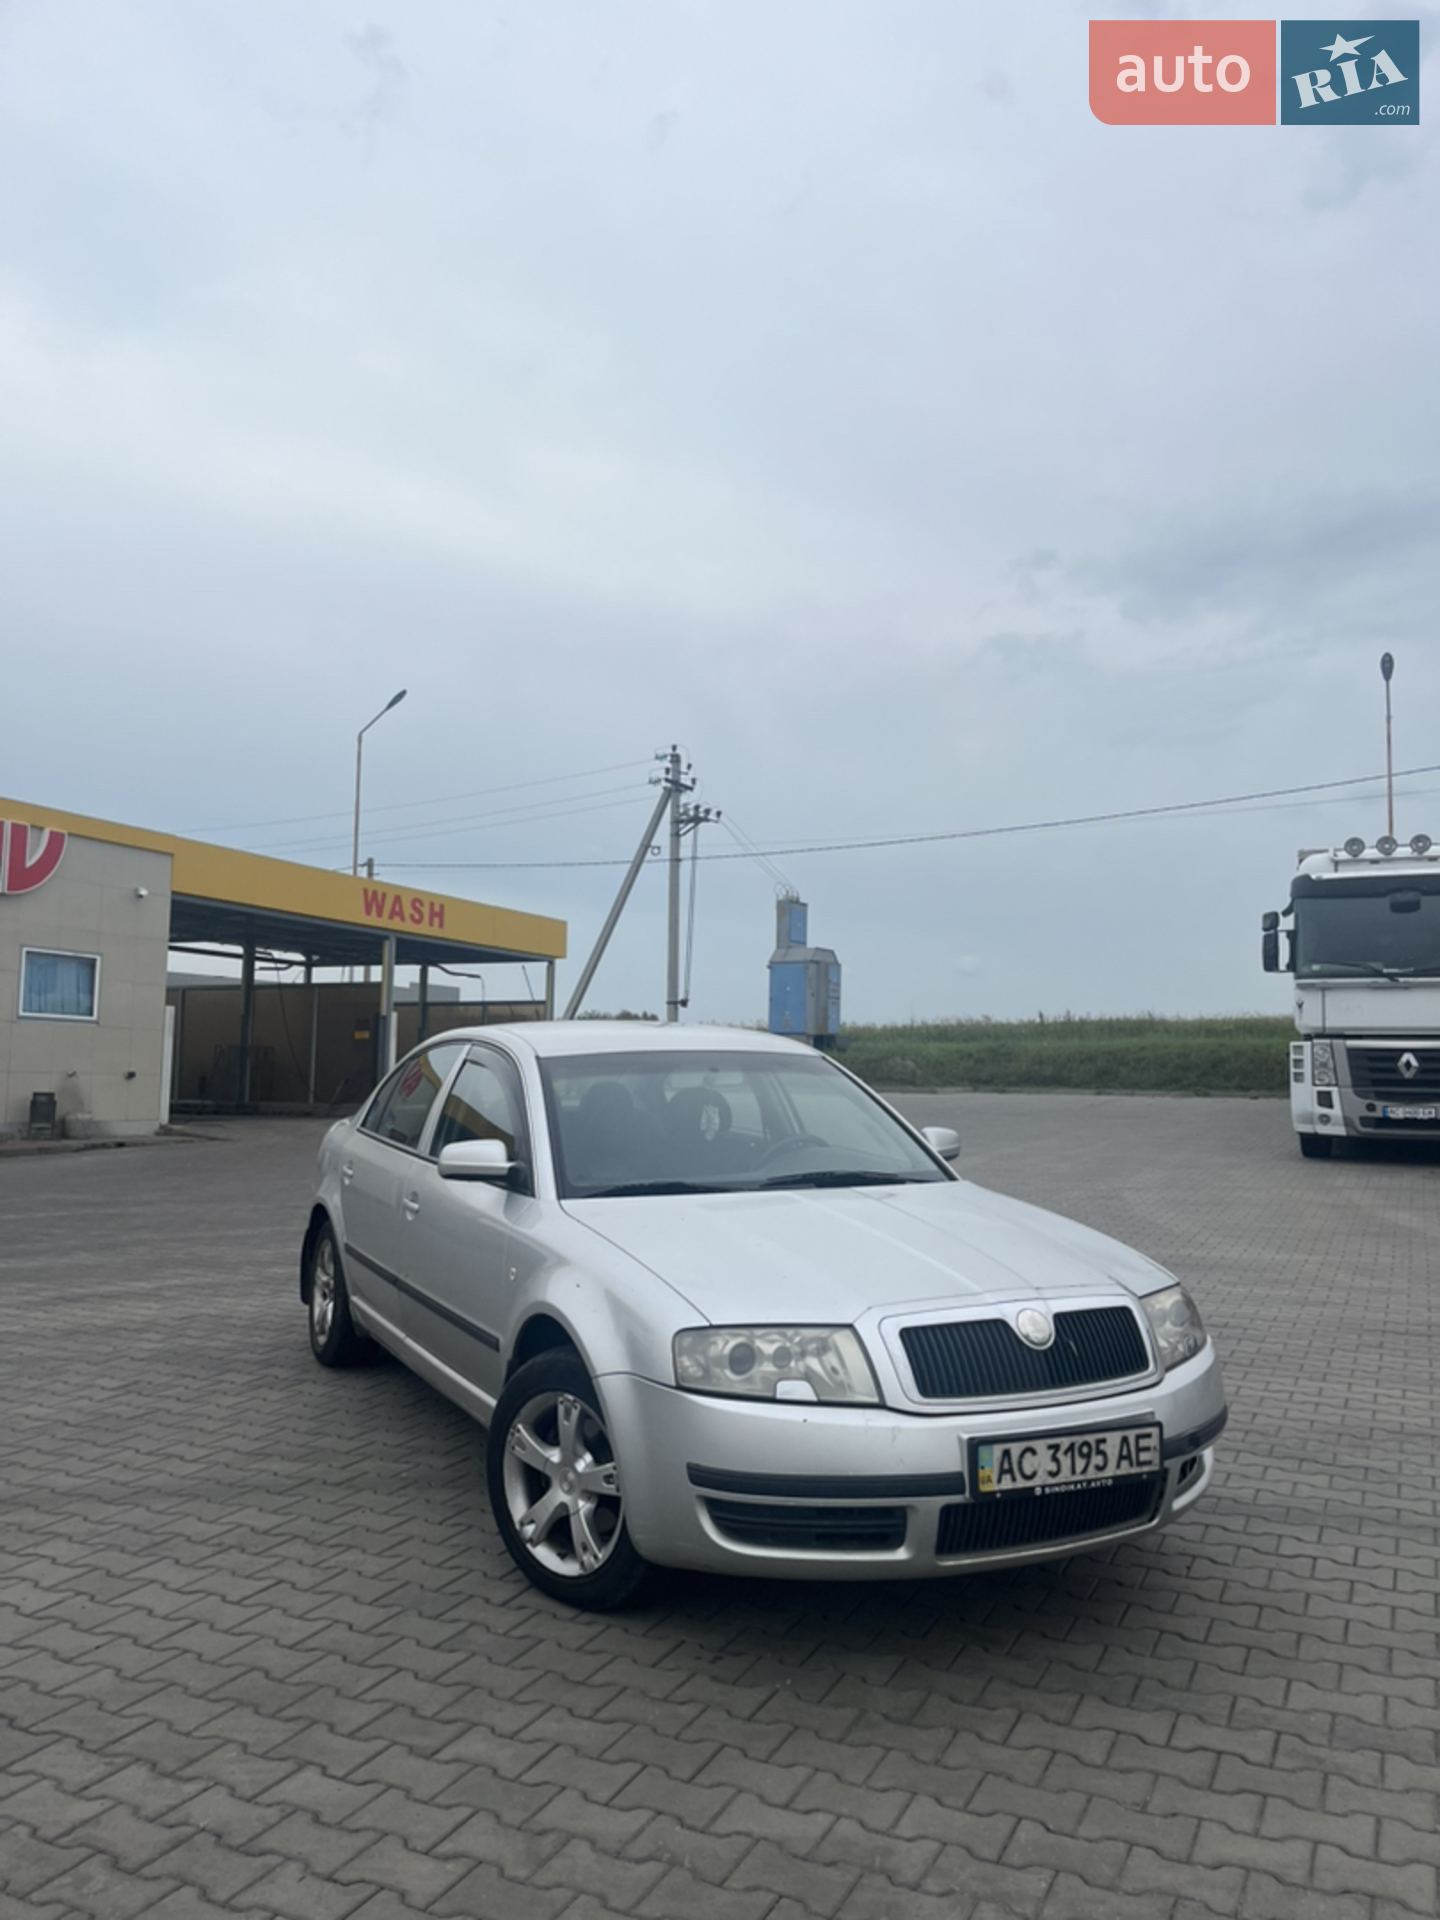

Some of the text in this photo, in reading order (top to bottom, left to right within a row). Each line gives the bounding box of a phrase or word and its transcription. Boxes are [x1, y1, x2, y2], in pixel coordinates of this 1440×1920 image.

[362, 887, 446, 930] WASH
[996, 1432, 1153, 1485] AC 3195 AE
